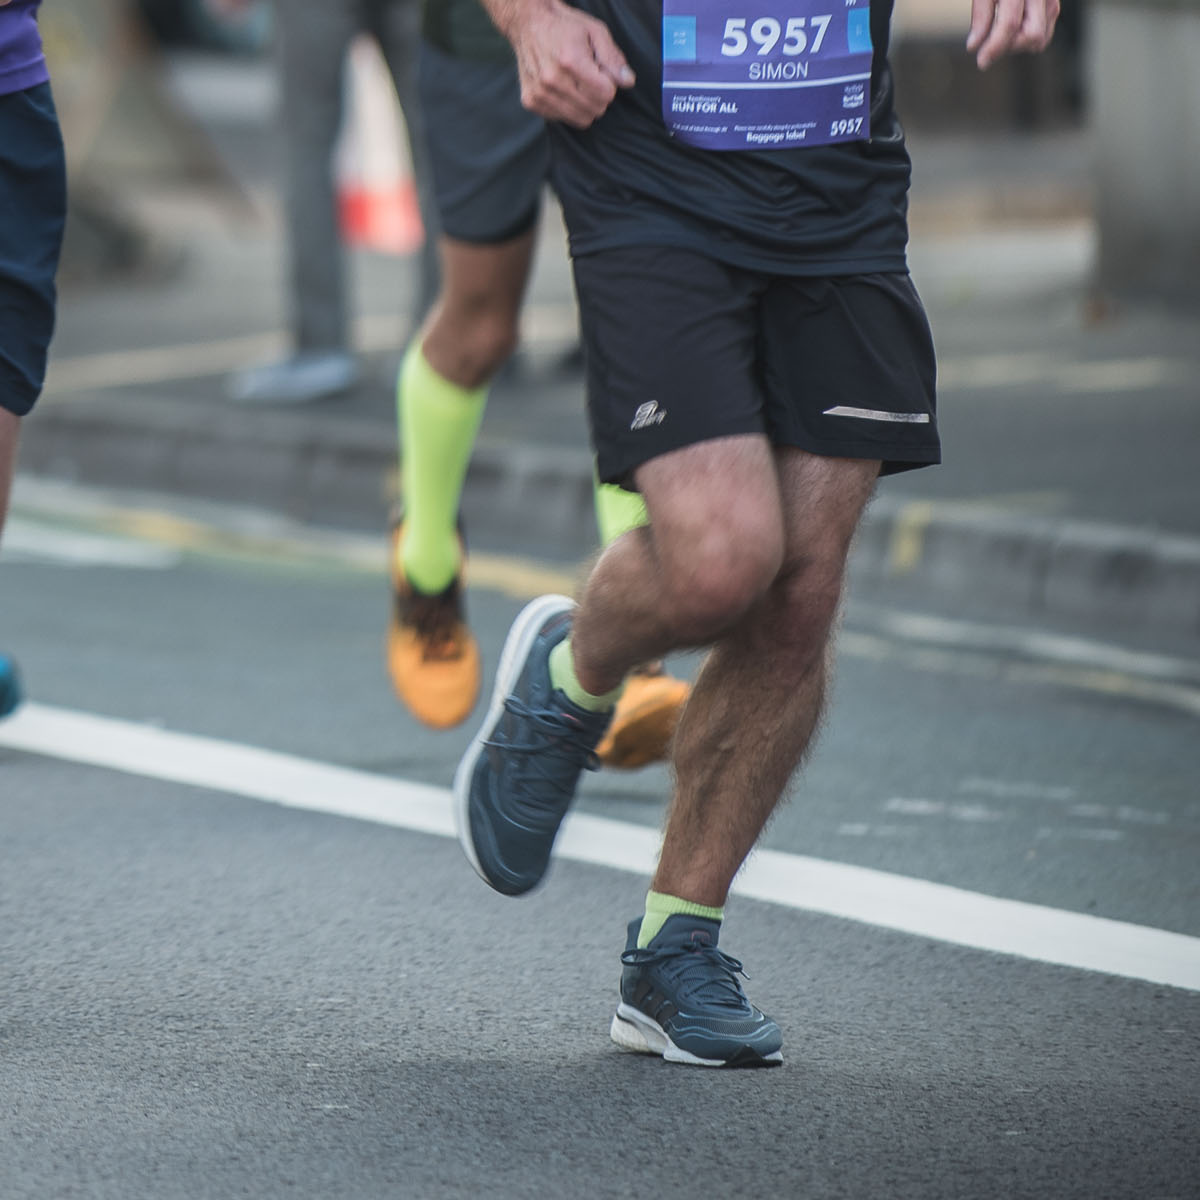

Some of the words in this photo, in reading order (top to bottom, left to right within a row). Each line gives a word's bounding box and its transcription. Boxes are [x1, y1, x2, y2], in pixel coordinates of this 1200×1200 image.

[721, 15, 832, 56] 5957
[749, 62, 808, 80] SIMON
[672, 102, 694, 112] RUN
[696, 102, 717, 113] FOR
[719, 102, 738, 113] ALL
[830, 117, 864, 137] 5957
[746, 131, 784, 144] Baggage
[785, 129, 806, 140] label
